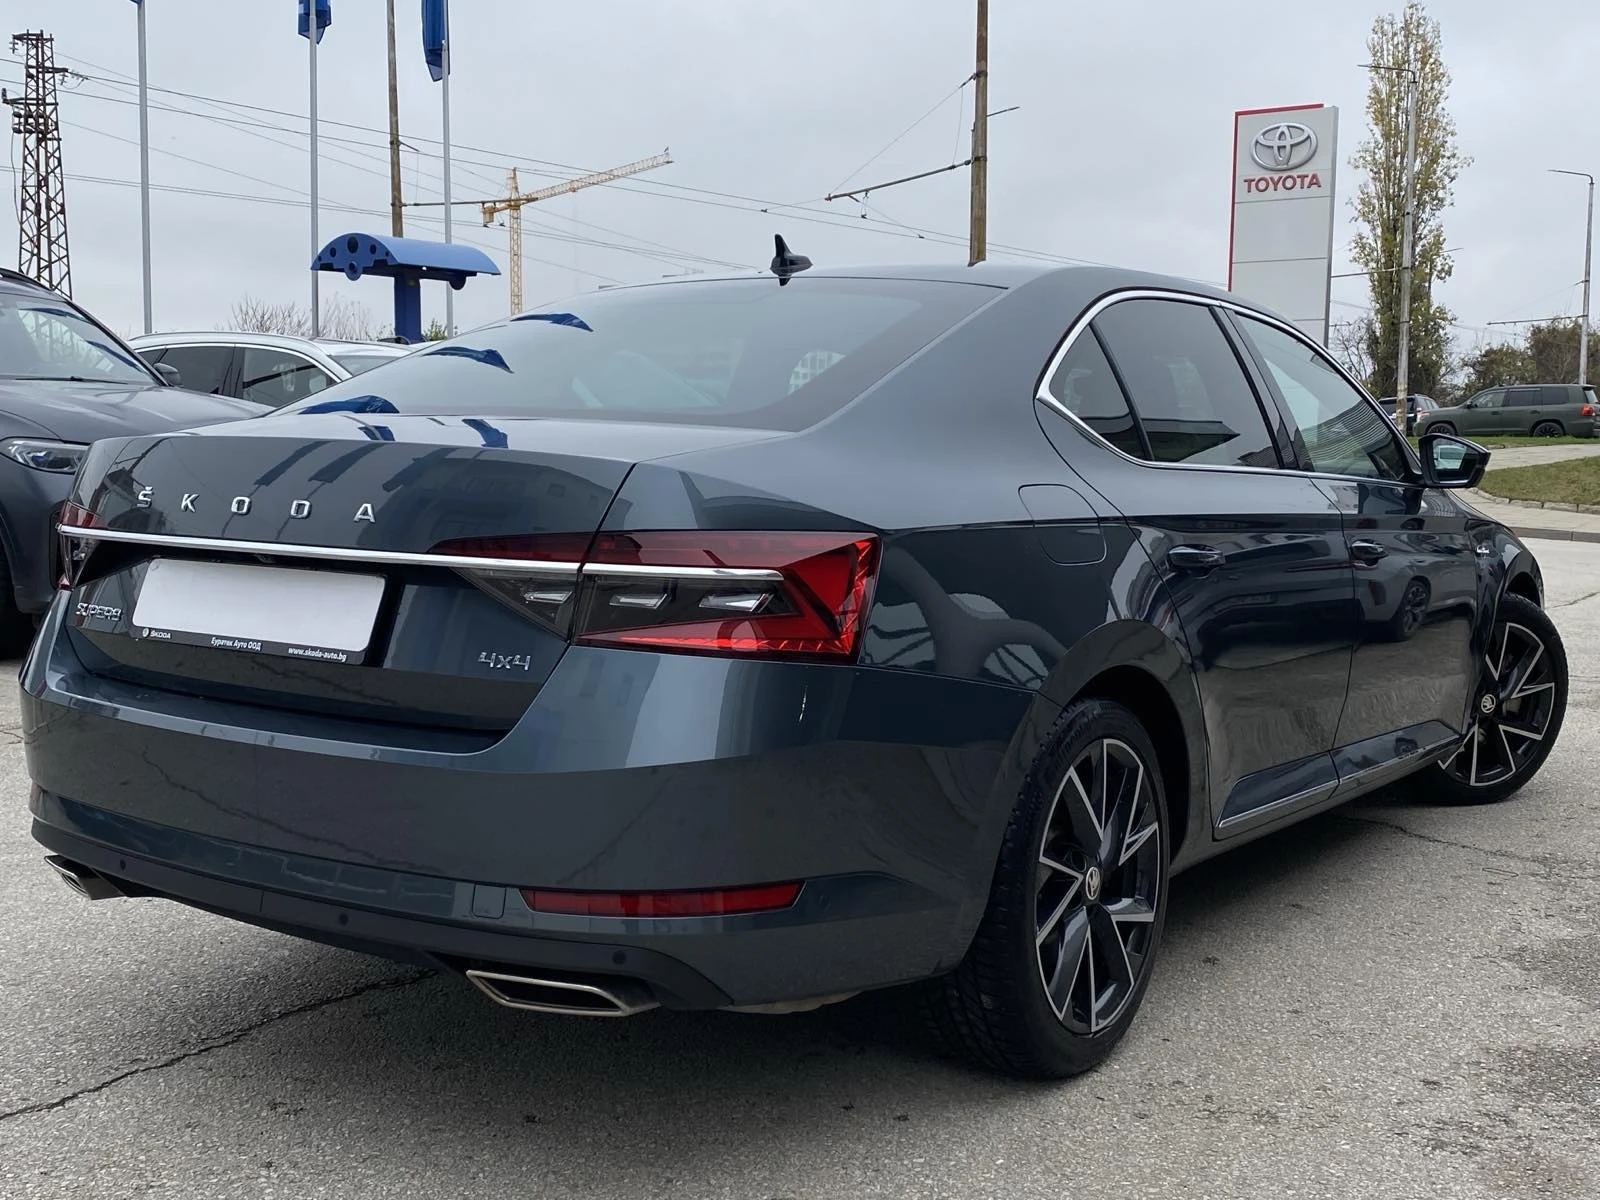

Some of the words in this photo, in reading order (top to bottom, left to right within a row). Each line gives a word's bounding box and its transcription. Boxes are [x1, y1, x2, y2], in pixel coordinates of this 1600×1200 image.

[1243, 173, 1322, 193] TOYOTA
[136, 486, 377, 524] ŠKODA
[288, 647, 347, 662] www.skoda-auto.bg
